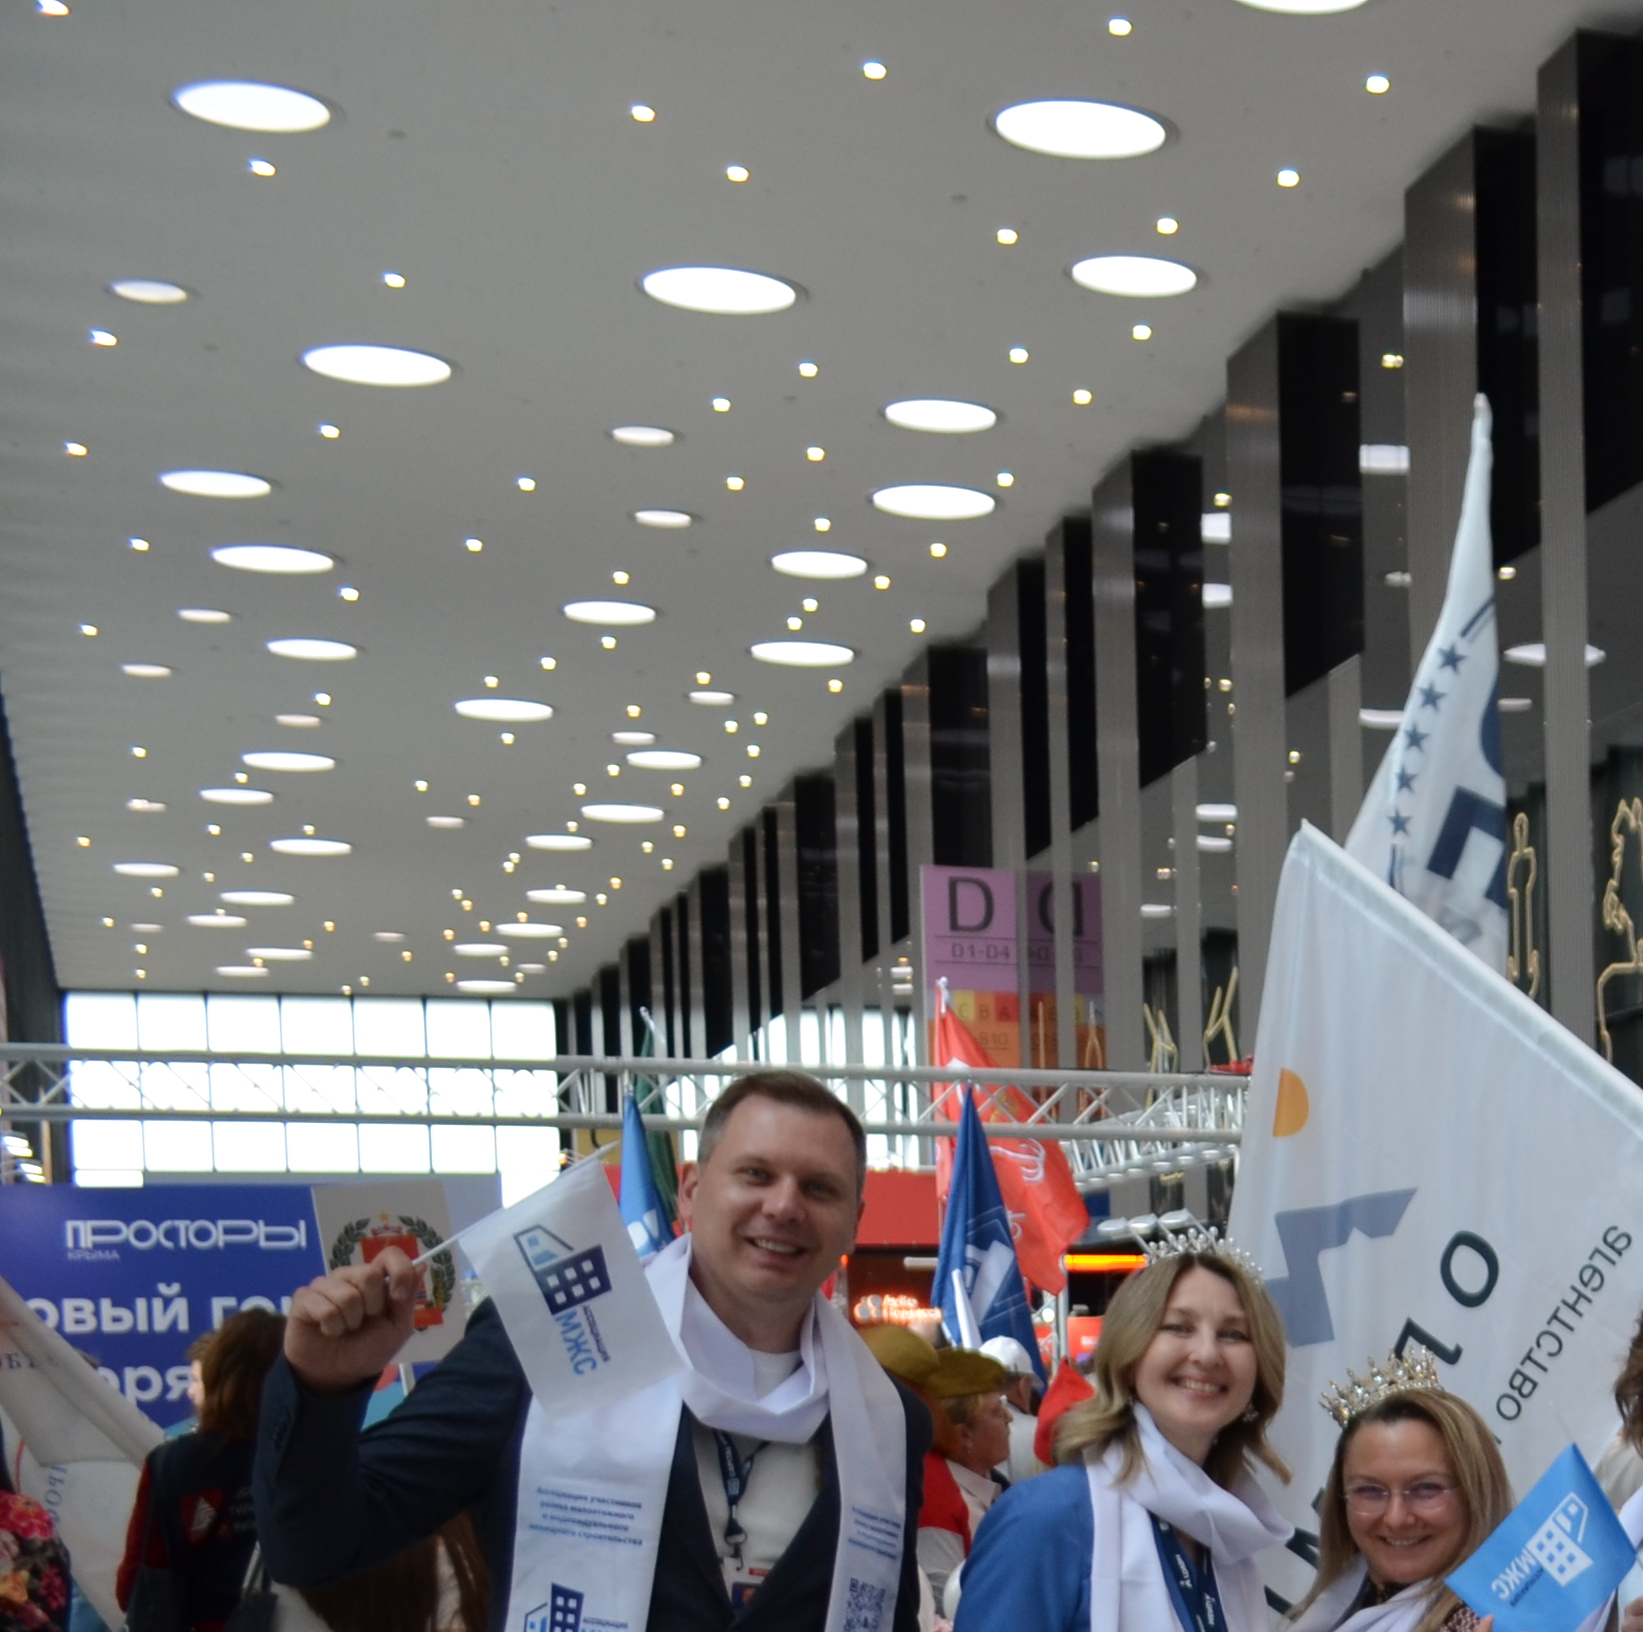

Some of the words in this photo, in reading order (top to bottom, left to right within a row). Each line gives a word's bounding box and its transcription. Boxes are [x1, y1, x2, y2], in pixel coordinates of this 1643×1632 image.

[949, 877, 994, 931] D
[65, 1219, 308, 1250] ПРОСТОРЫ
[27, 1282, 191, 1334] овый
[554, 1308, 597, 1376] МЖС
[1491, 1547, 1537, 1600] МЖС
